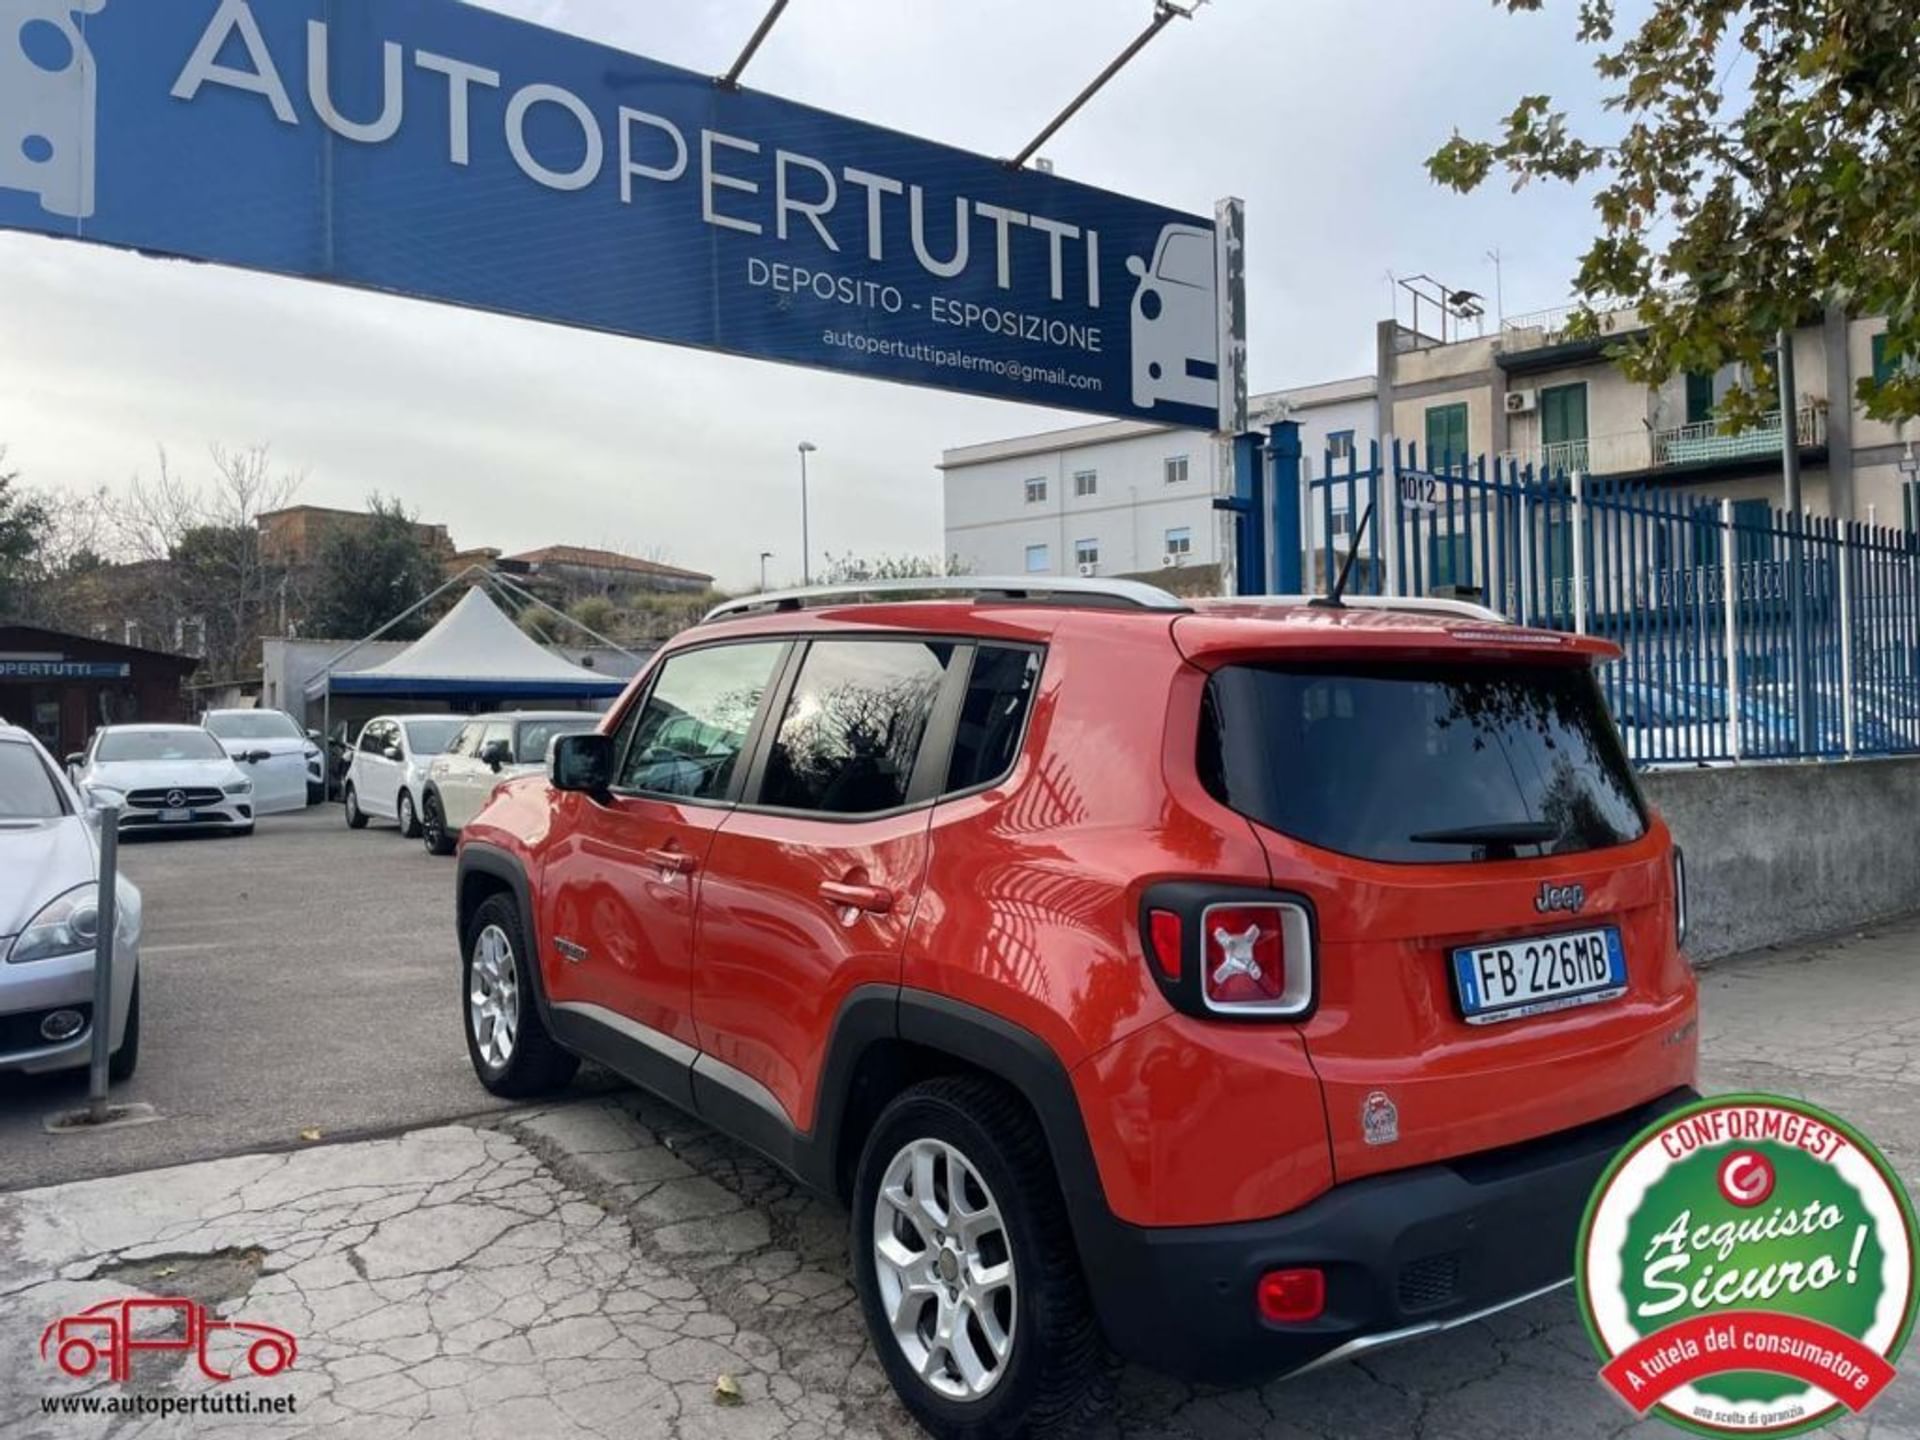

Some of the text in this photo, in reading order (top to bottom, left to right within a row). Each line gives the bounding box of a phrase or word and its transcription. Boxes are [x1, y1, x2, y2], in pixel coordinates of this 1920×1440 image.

[171, 0, 1101, 308] AUTOPERTUTTI
[748, 257, 902, 313] DEPOSITO
[931, 296, 1102, 353] ESPOSIZIONE
[823, 328, 1102, 391] autopertuttipalermo@gmail.com
[1401, 476, 1436, 503] 1012
[1536, 883, 1585, 914] Jeep
[1477, 950, 1517, 1001] FB
[1525, 936, 1607, 992] 226MB
